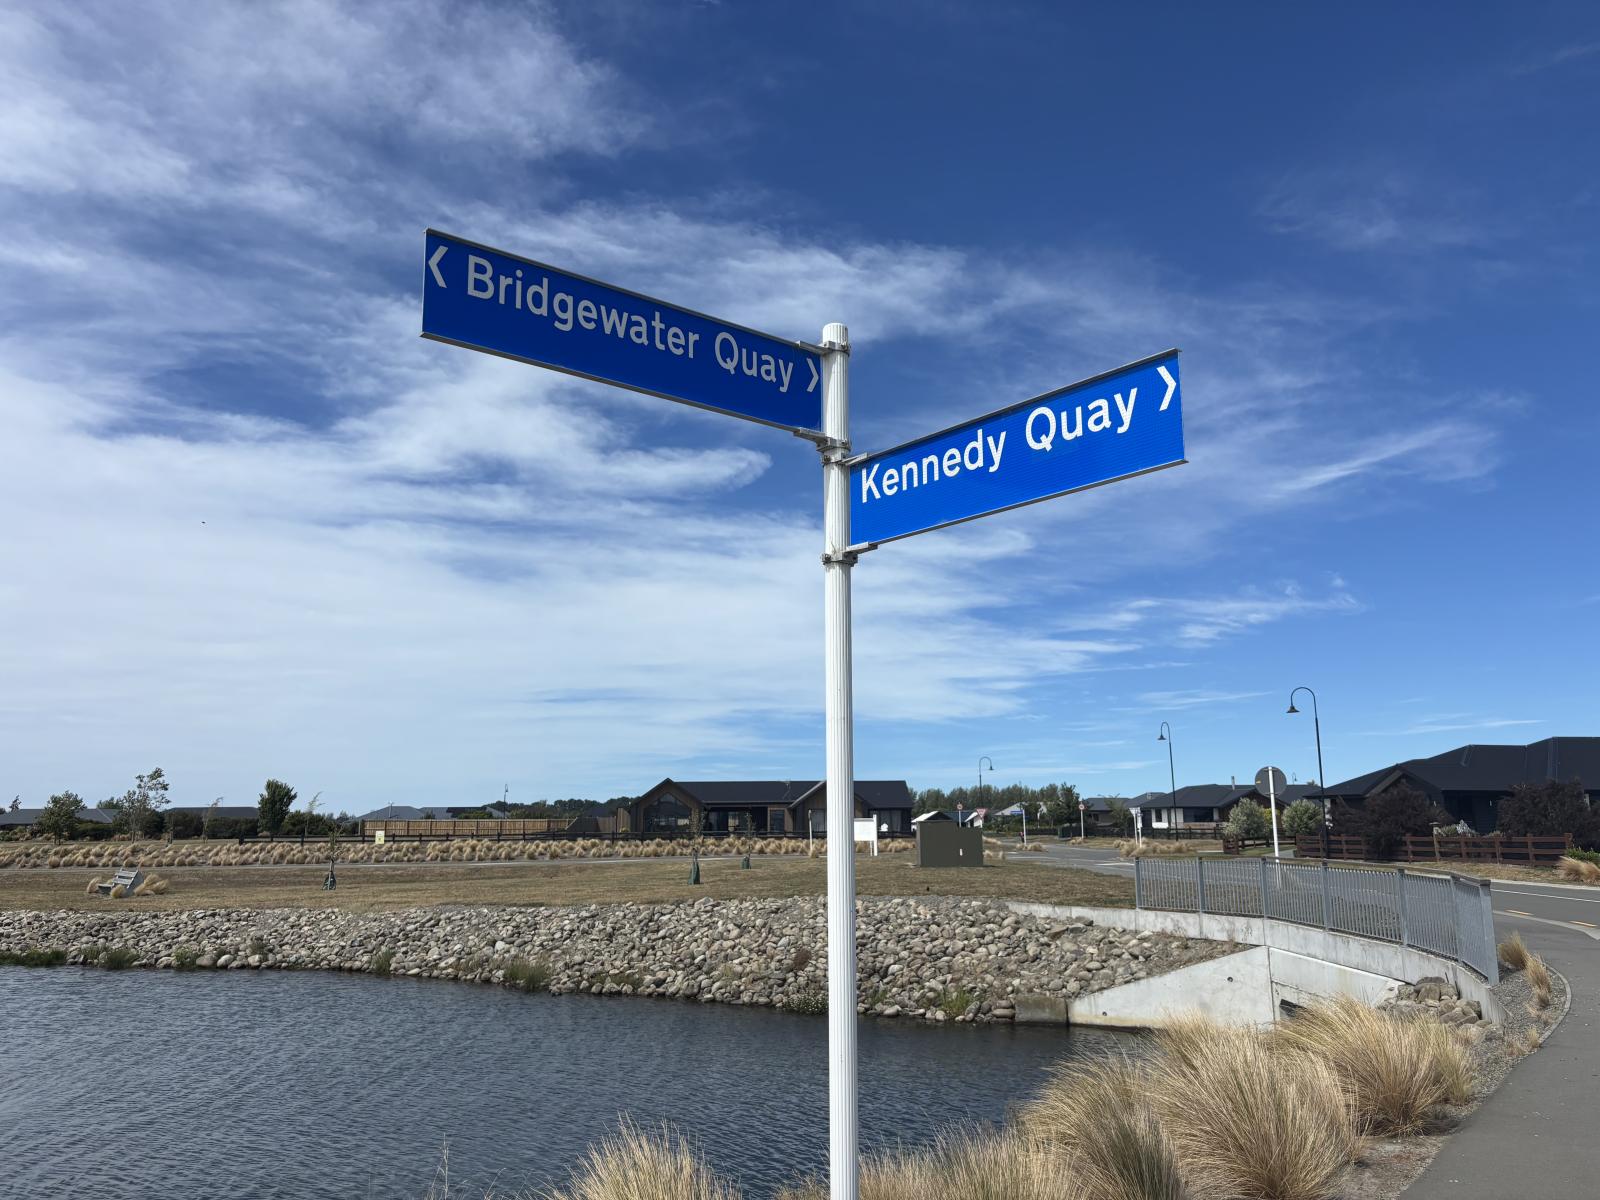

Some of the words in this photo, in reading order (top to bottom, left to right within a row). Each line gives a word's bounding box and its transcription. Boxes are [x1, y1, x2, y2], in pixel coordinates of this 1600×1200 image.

[467, 255, 699, 360] Bridgewater
[714, 332, 794, 393] Quay
[861, 428, 1007, 504] Kennedy
[1025, 387, 1138, 452] Quay
